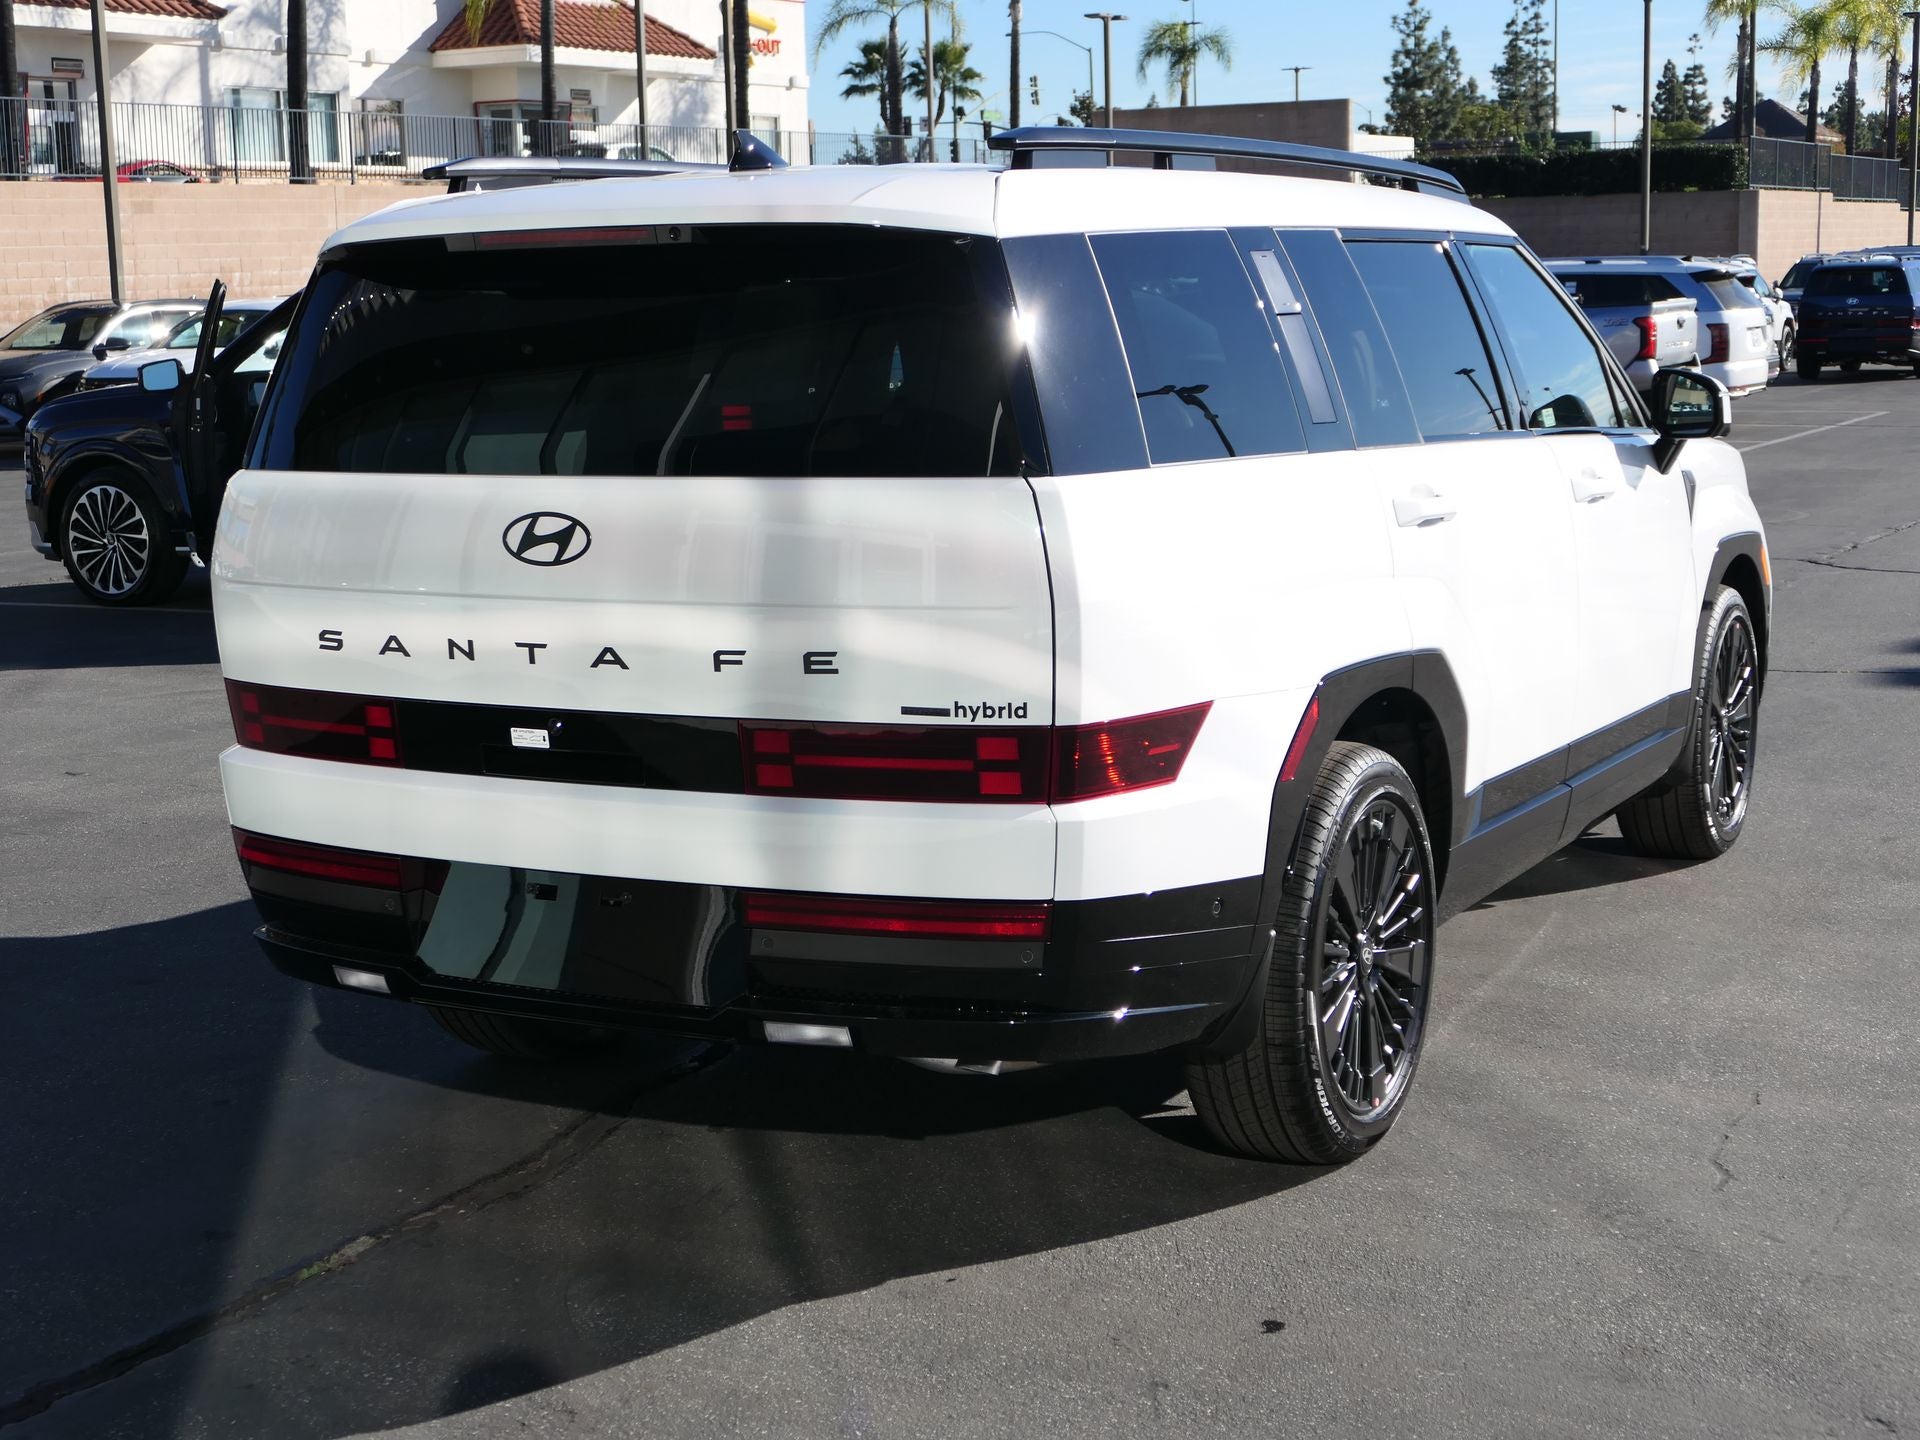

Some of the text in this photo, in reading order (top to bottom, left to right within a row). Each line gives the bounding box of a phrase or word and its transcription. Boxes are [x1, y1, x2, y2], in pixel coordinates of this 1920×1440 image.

[318, 629, 840, 675] SANTA FE
[953, 700, 1028, 723] hybrid
